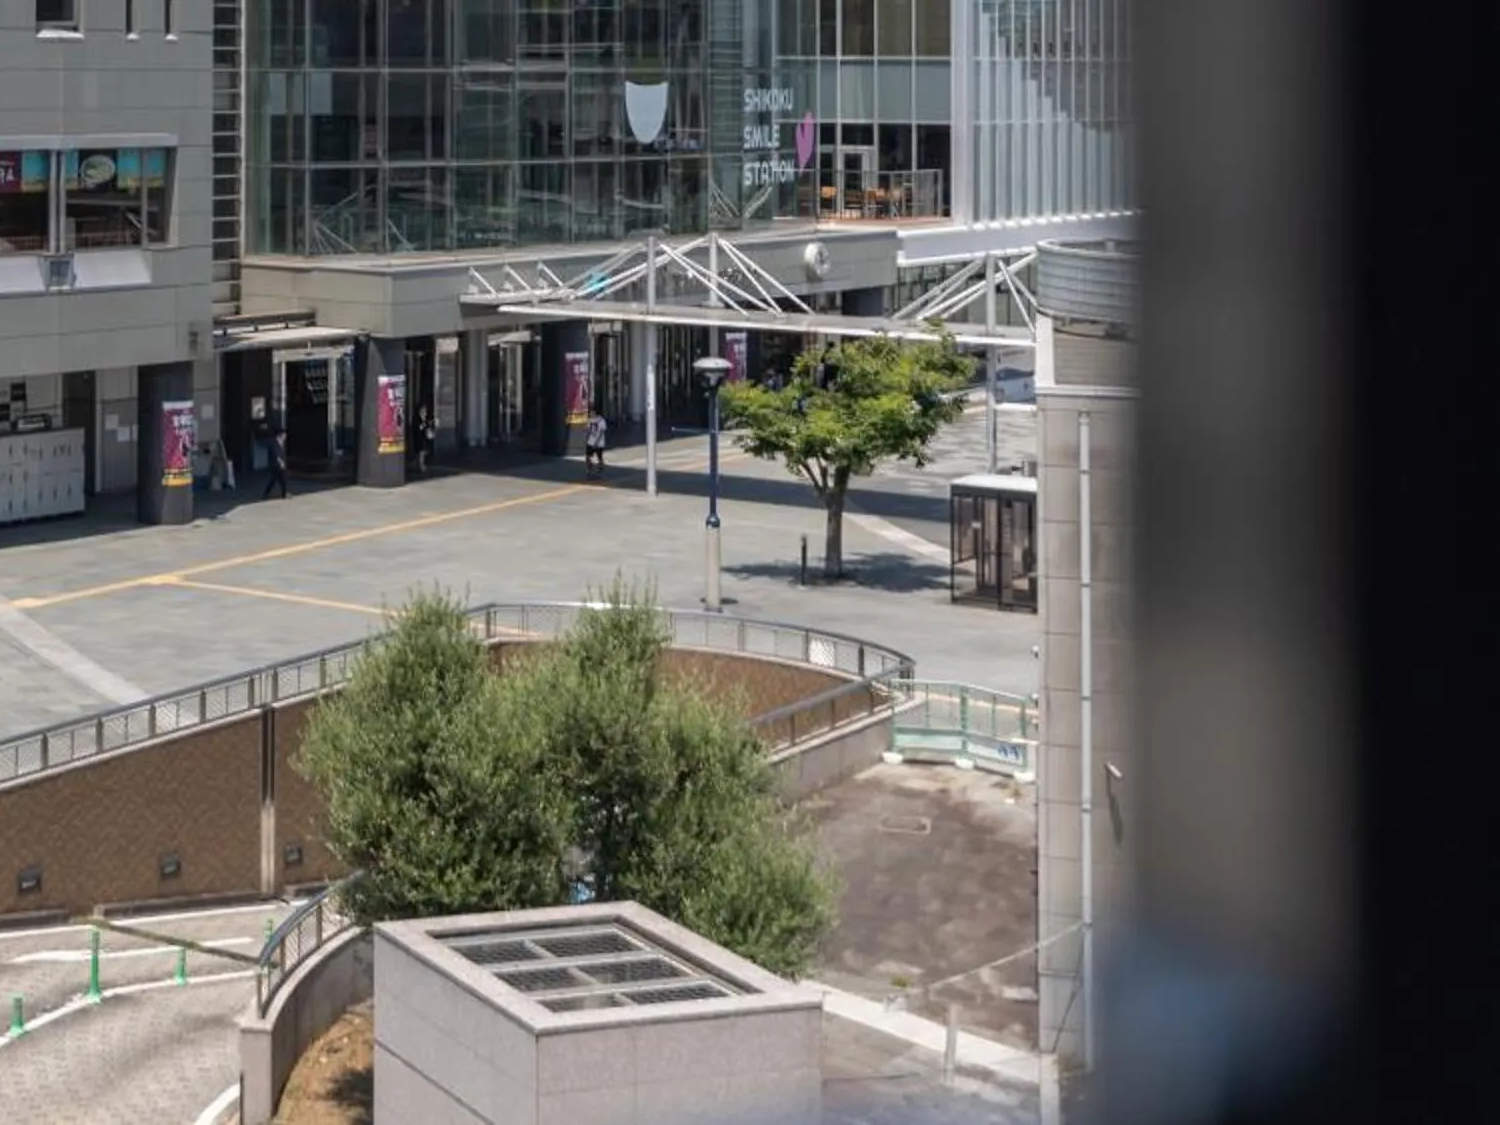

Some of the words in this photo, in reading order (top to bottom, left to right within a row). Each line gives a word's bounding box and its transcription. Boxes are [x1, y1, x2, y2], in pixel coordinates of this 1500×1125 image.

[743, 87, 793, 111] SHIKOKU
[743, 124, 780, 149] SMILE
[743, 159, 795, 186] STATION
